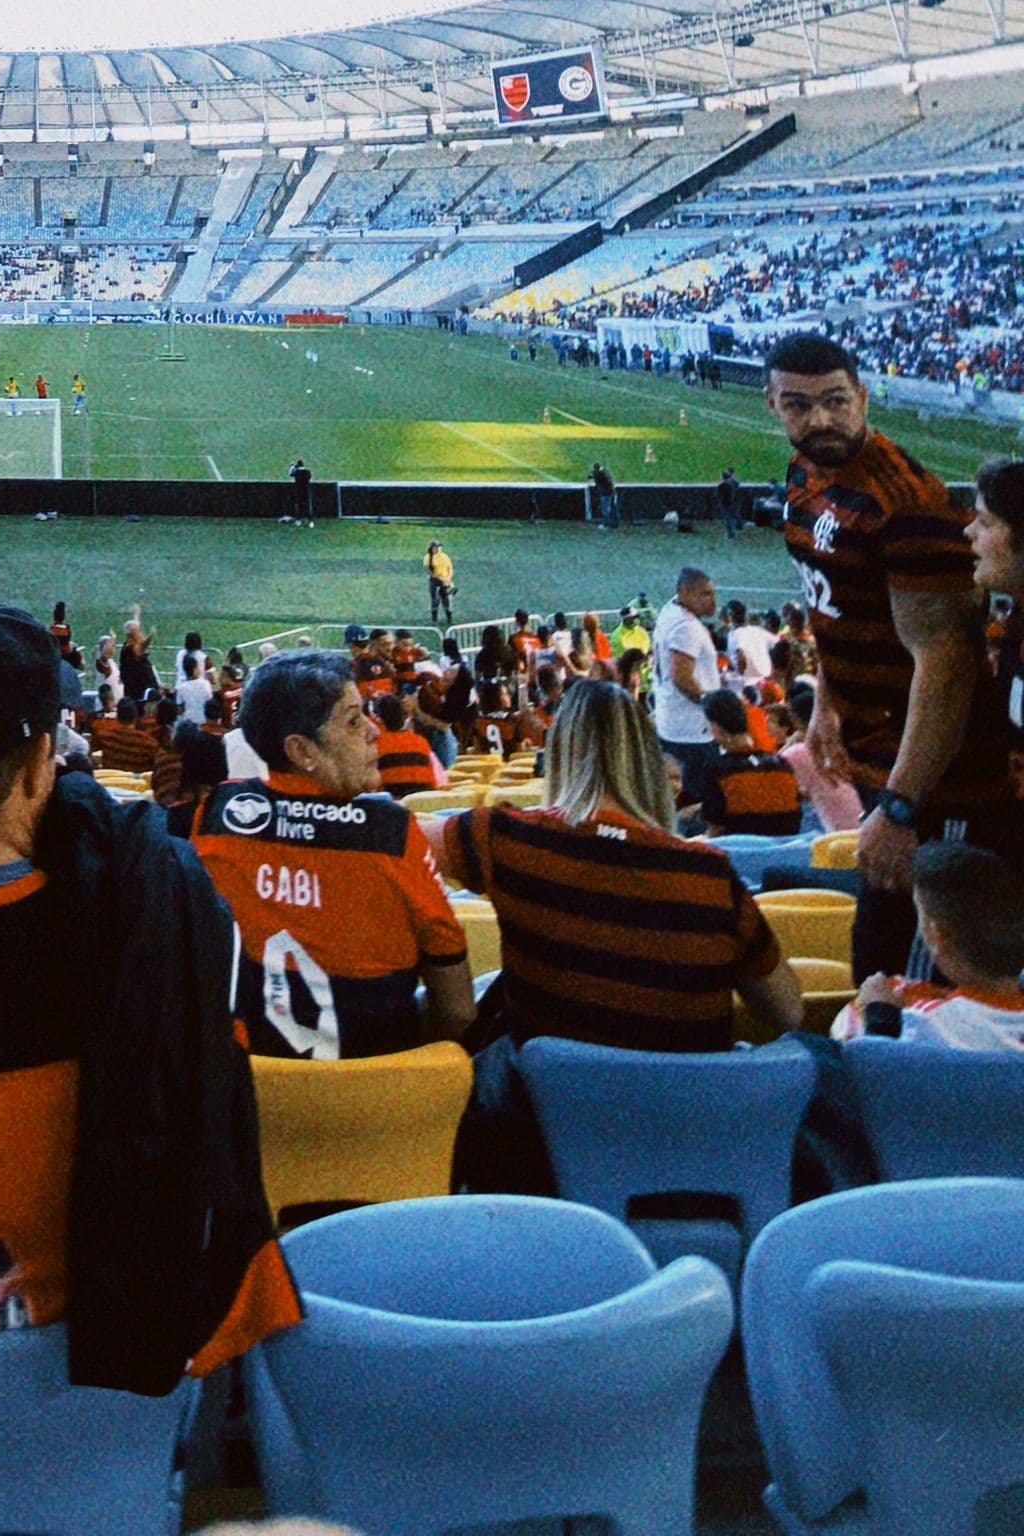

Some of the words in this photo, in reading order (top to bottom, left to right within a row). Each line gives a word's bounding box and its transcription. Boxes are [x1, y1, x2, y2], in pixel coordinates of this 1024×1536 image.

[226, 314, 278, 325] HAVAN
[276, 799, 367, 825] mercado
[276, 817, 316, 840] livre
[256, 863, 321, 908] GABI
